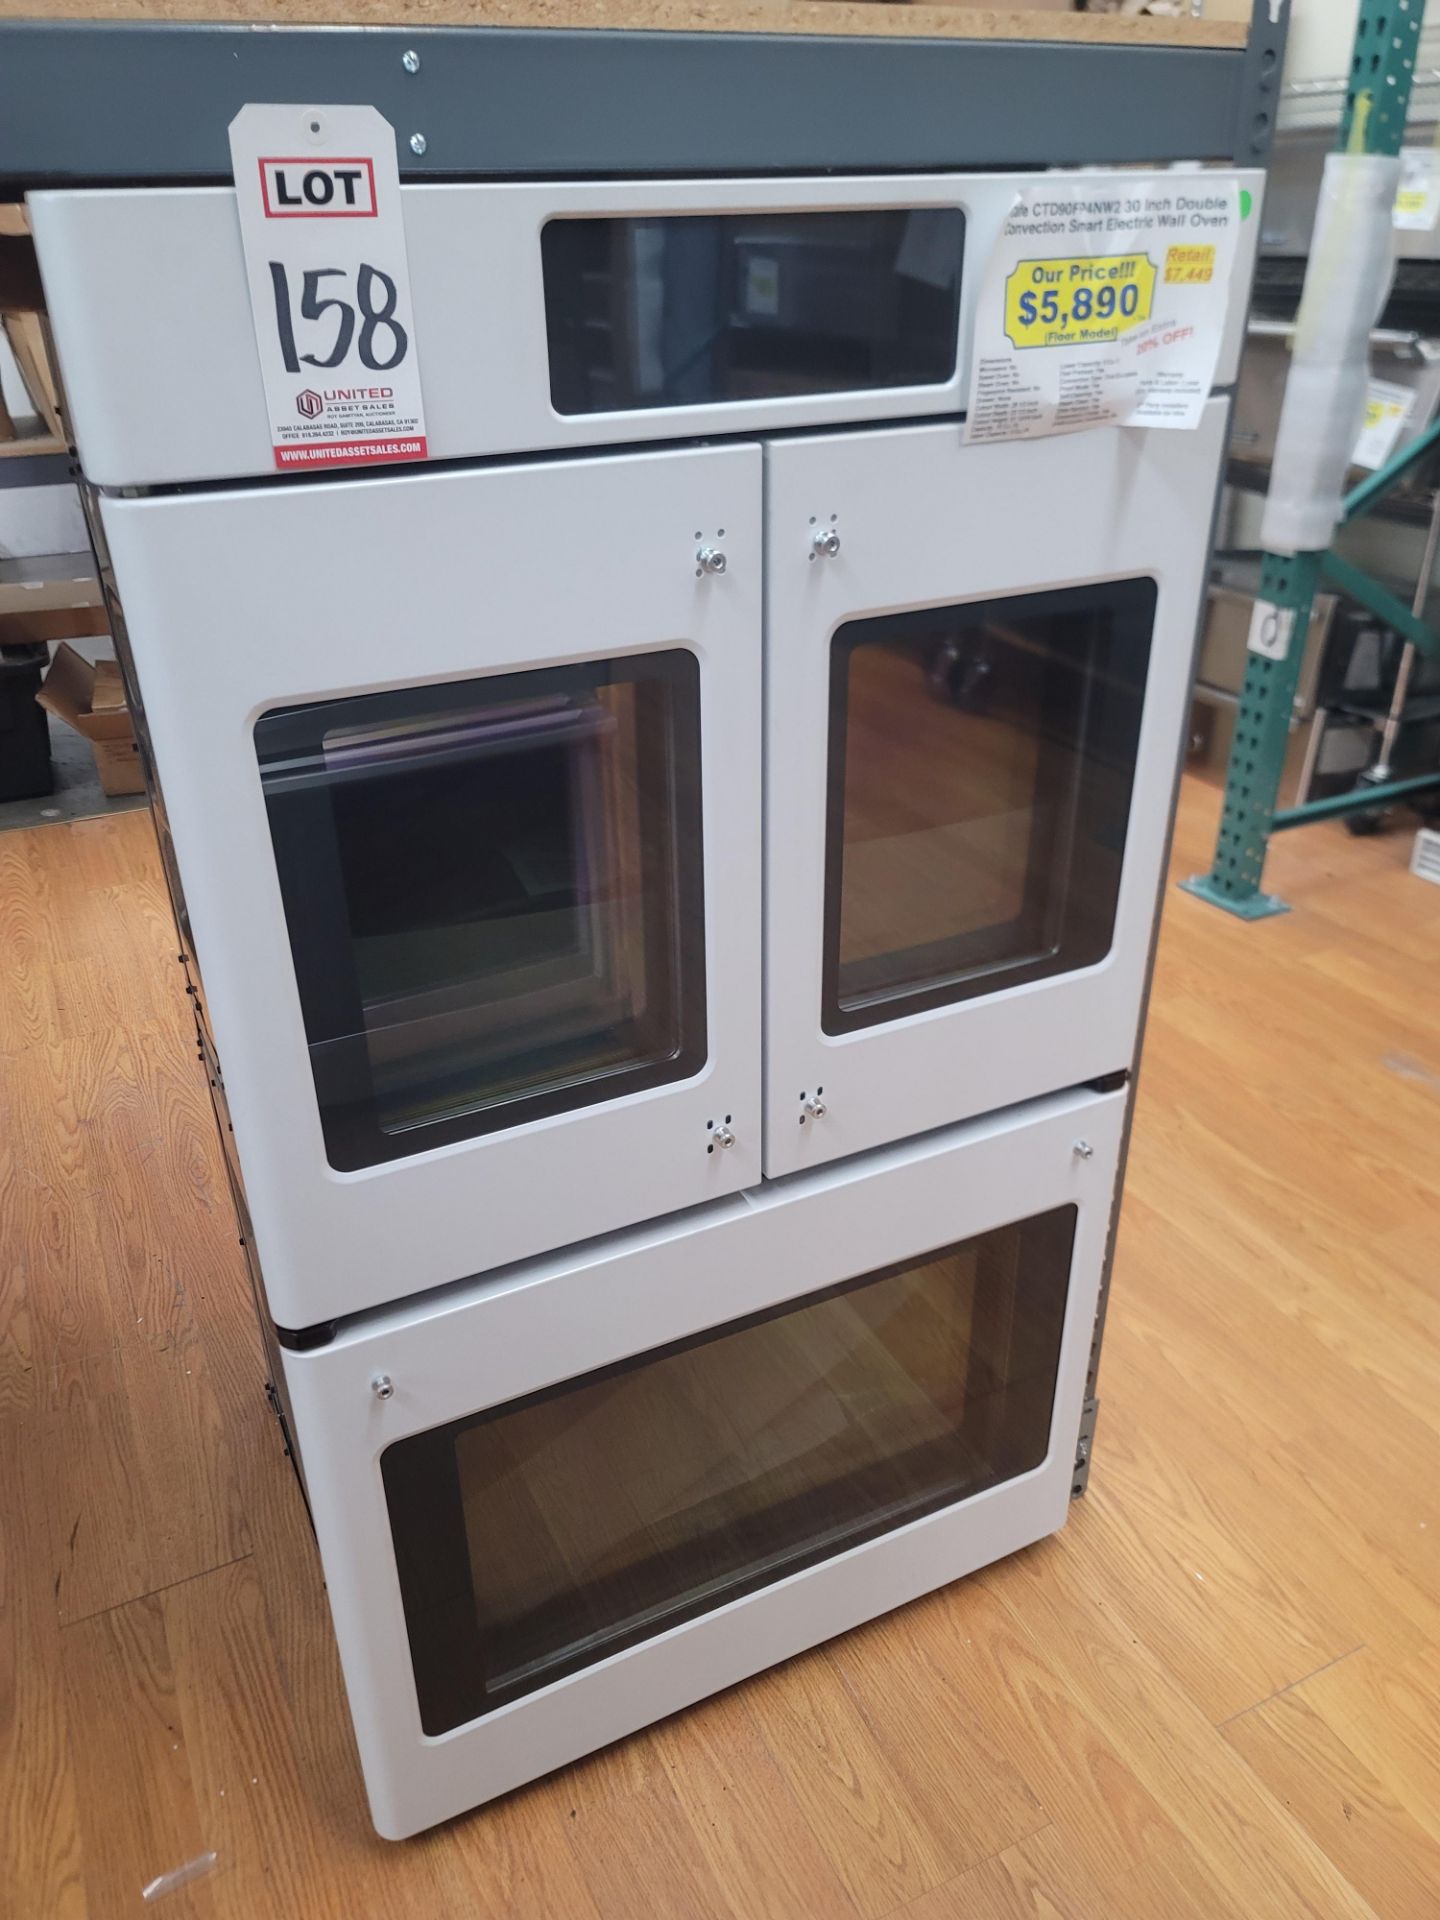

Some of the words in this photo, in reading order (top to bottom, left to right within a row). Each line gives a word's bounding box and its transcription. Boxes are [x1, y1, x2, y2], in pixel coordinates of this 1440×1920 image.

[275, 170, 362, 205] LOT
[1125, 200, 1141, 213] 30
[1145, 198, 1171, 212] Inch
[1176, 196, 1227, 211] Double
[1070, 219, 1103, 233] Smart
[1107, 216, 1153, 231] Electric
[1157, 214, 1186, 228] Wall
[1190, 213, 1228, 228] Oven
[1032, 266, 1063, 283] Our
[1069, 261, 1137, 281] Price!!!
[1164, 267, 1213, 283] $7,449
[269, 260, 407, 373] 158
[1018, 284, 1139, 330] $5,890
[1045, 331, 1076, 346] (Floor
[1080, 326, 1119, 341] Model)
[1163, 326, 1195, 345] OFF!
[324, 387, 394, 401] UNITED
[364, 402, 395, 411] SALES
[282, 431, 299, 439] OFFICE
[293, 423, 323, 431] CALABASAS
[280, 442, 421, 462] WWW.UNITEDASSETSALES.COM
